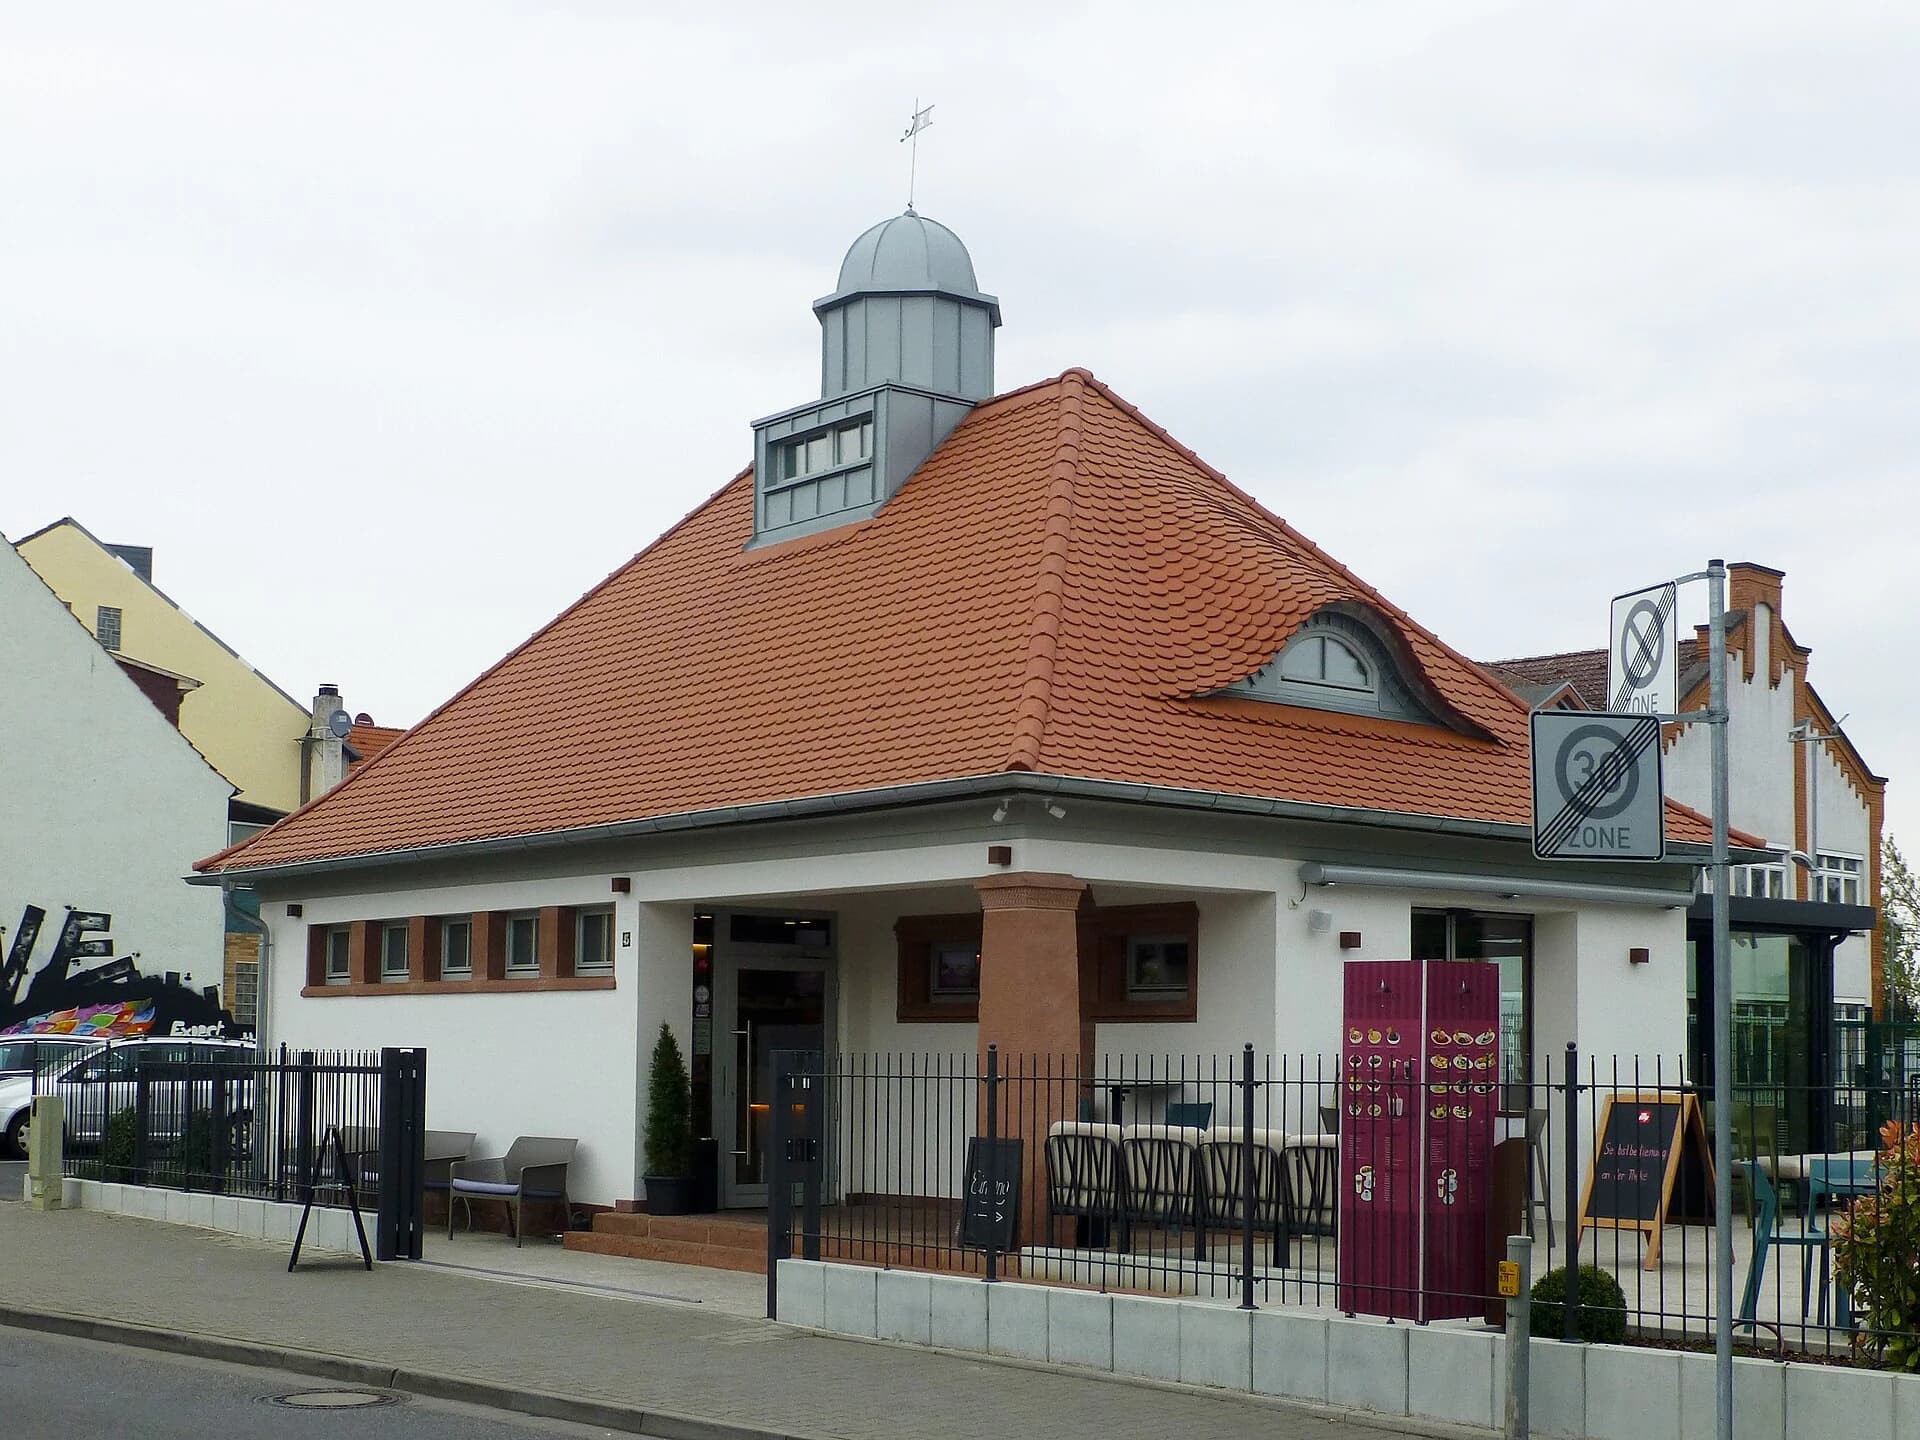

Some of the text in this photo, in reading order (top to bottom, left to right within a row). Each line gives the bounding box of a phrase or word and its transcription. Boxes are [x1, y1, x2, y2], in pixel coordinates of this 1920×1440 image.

[1625, 693, 1658, 713] ZONE
[1573, 751, 1621, 793] 30
[1568, 826, 1631, 849] ZONE
[170, 1020, 226, 1038] Expect
[1604, 1142, 1666, 1160] Sebstbeienug
